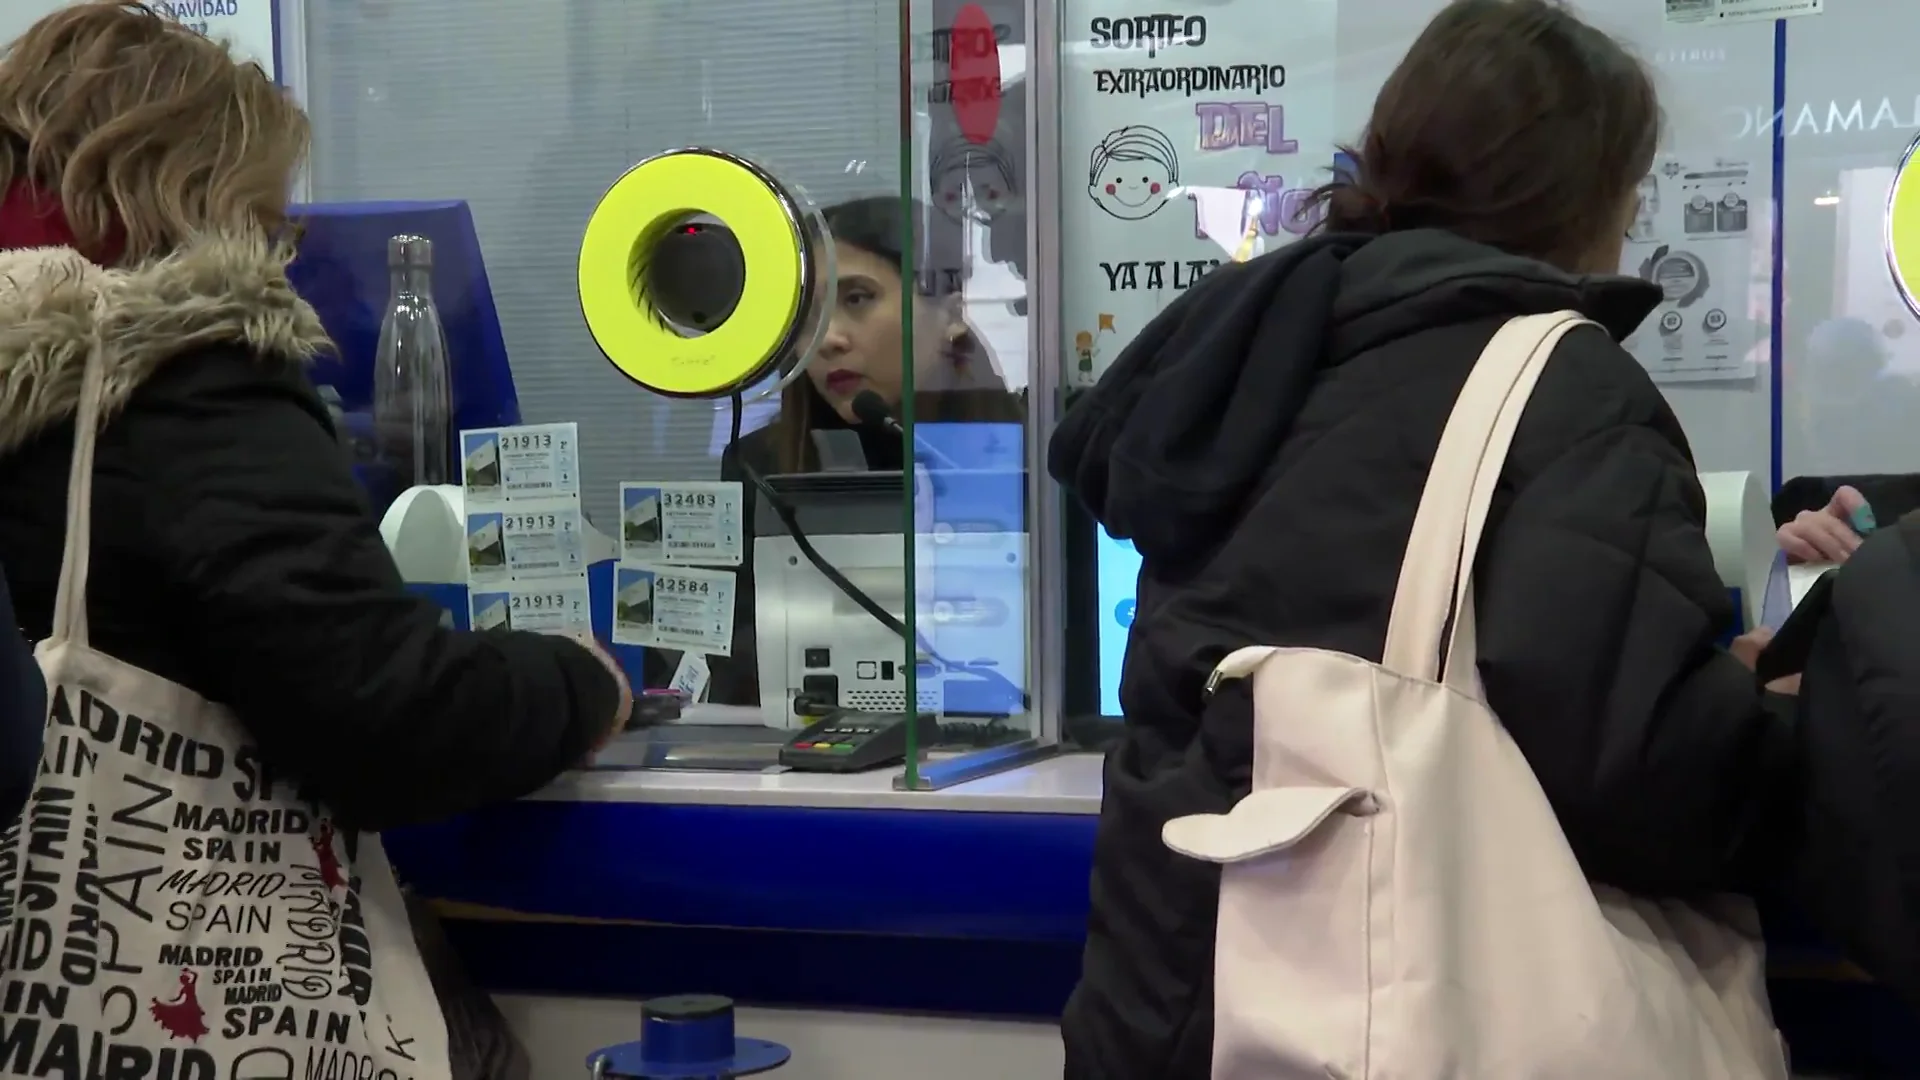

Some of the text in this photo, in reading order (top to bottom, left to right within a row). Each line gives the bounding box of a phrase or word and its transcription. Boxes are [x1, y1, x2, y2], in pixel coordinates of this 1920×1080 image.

[1090, 14, 1206, 58] SORTEO
[1094, 64, 1285, 98] EXTRAORDINARIO
[1195, 101, 1298, 153] DEL
[1099, 261, 1139, 291] YA
[1145, 261, 1166, 289] A
[501, 434, 552, 450] 21913
[664, 493, 716, 508] 32483
[505, 516, 556, 530] 21913
[655, 578, 709, 595] 42584
[512, 595, 564, 609] 21913
[48, 684, 225, 779] ADRID
[173, 802, 310, 835] MADRID
[182, 837, 281, 863] SPAIN
[156, 869, 286, 898] MADRID
[166, 901, 272, 934] SPAIN
[158, 944, 263, 967] MADRID
[224, 985, 282, 1006] MADRID
[222, 1005, 351, 1044] SPAIN
